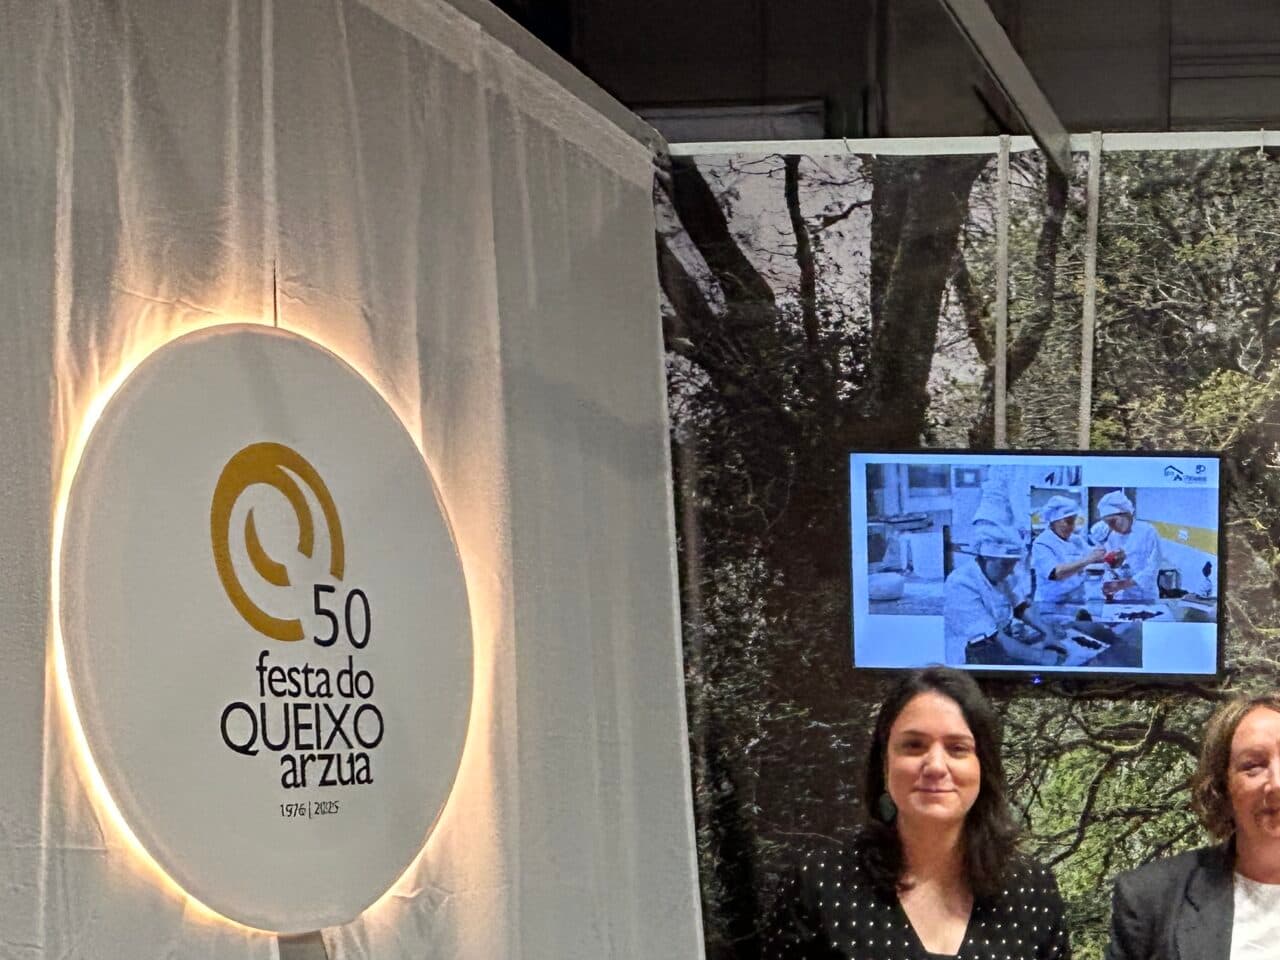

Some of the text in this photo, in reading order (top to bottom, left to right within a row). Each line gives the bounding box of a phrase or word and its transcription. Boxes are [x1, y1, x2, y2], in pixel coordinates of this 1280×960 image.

[313, 584, 372, 649] 50
[255, 650, 374, 699] festa do
[220, 701, 385, 756] QUEIXO
